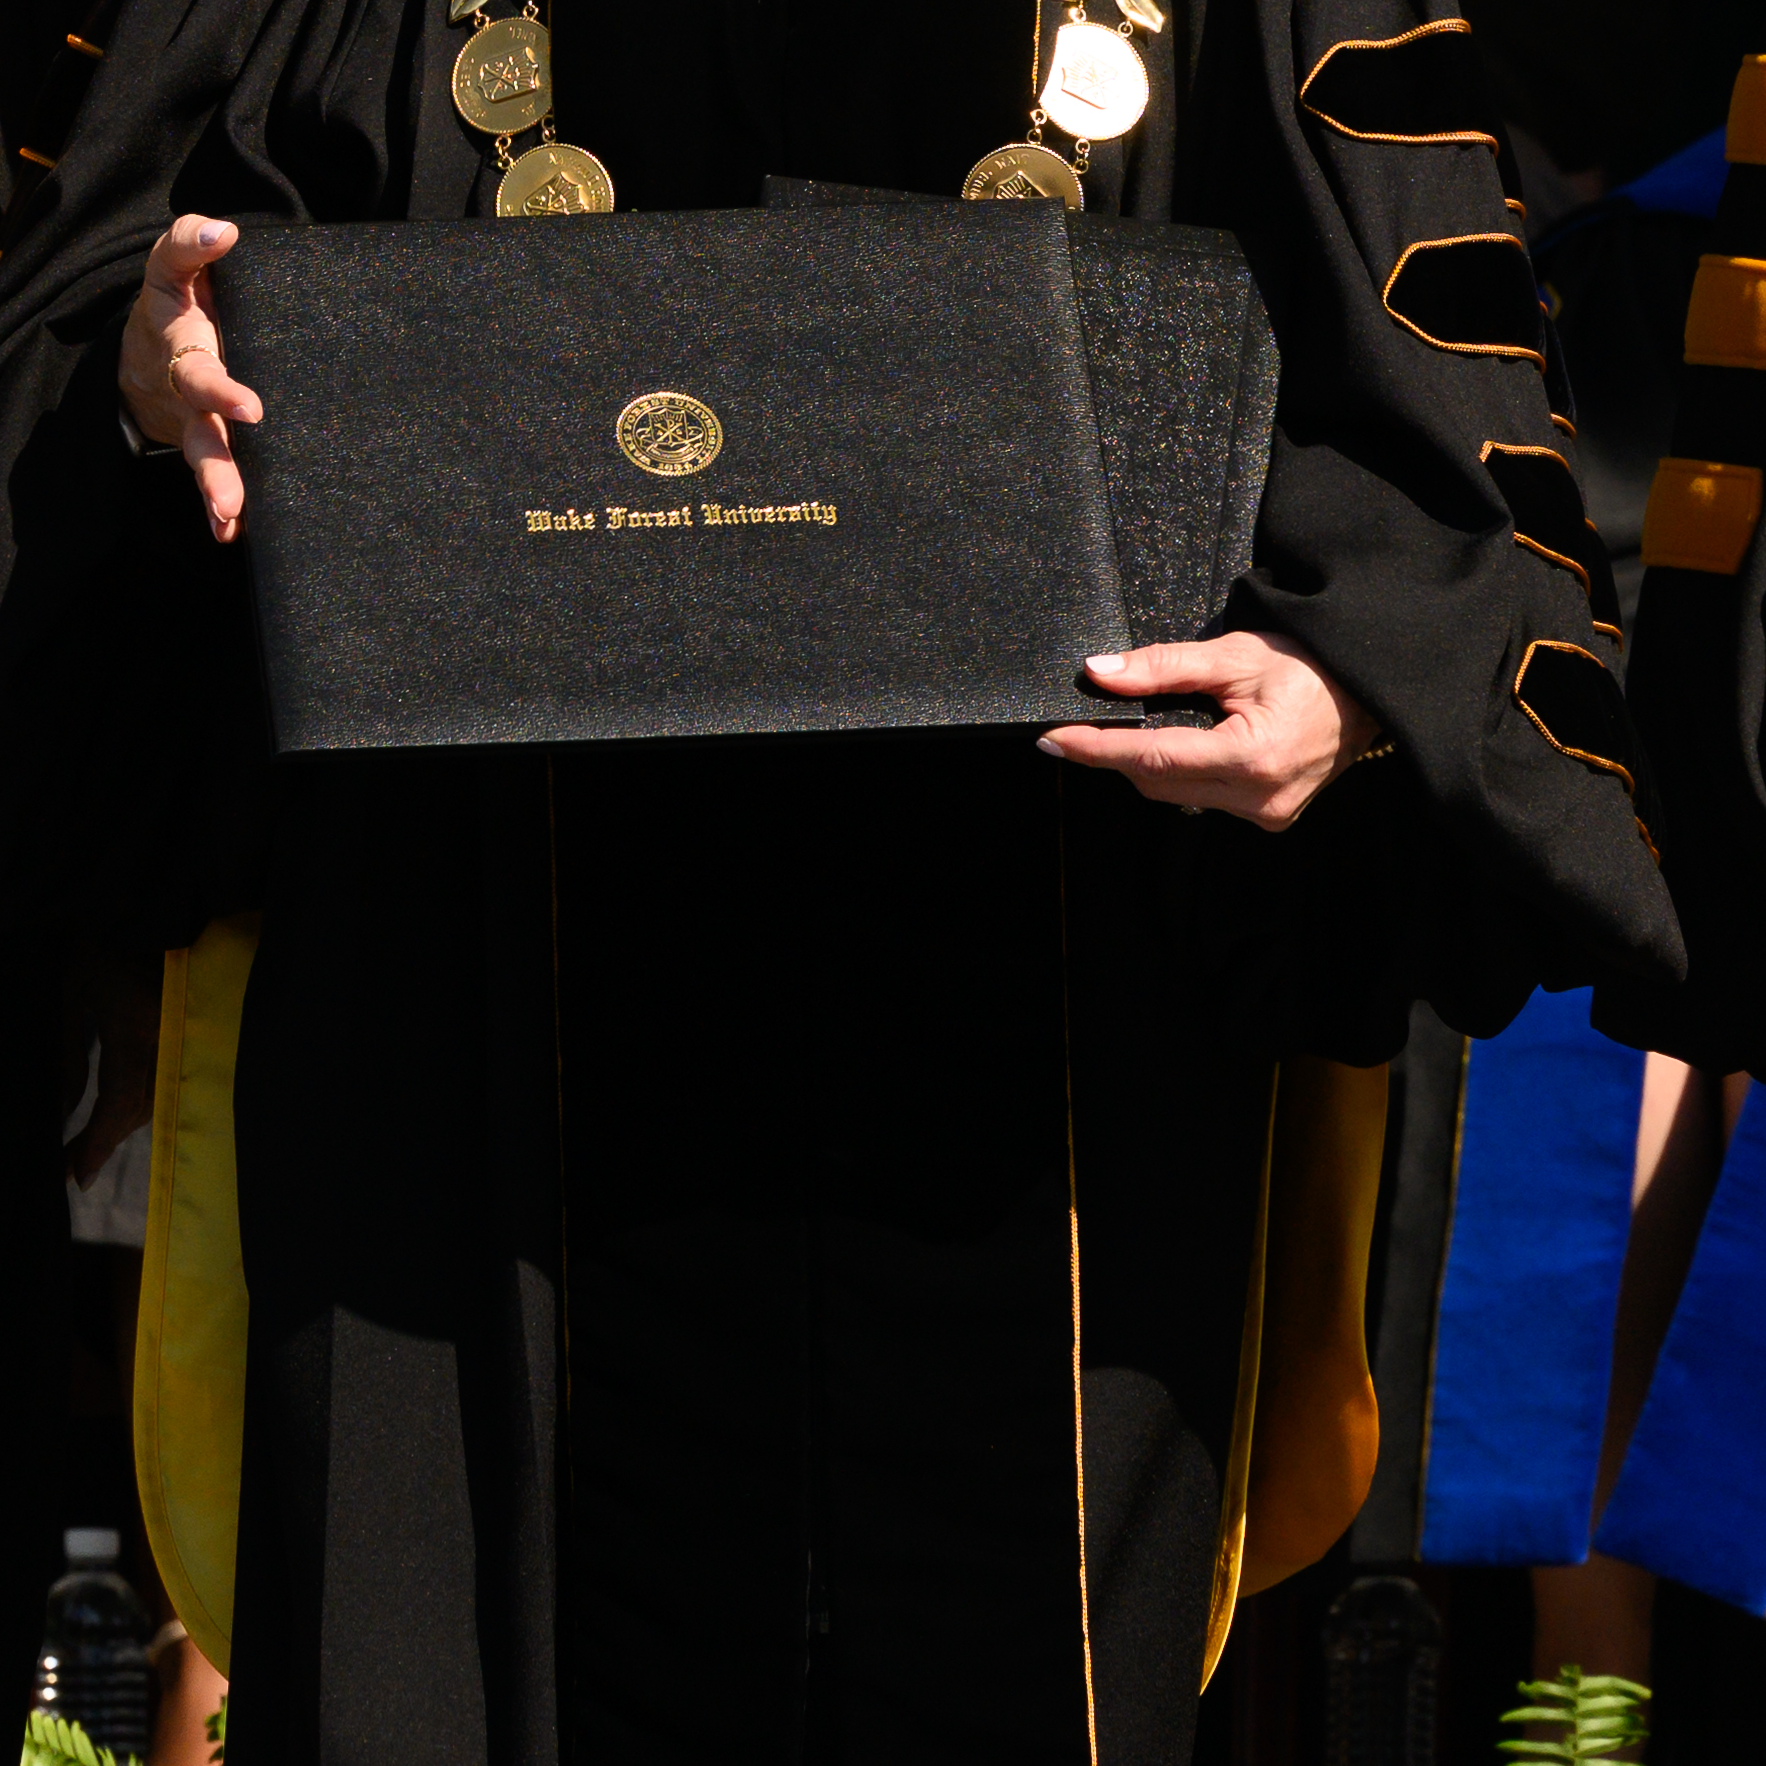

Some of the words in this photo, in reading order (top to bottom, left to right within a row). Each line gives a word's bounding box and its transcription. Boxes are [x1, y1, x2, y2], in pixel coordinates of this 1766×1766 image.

[525, 509, 595, 532] Wake
[606, 506, 694, 529] Forest
[702, 502, 837, 526] University
